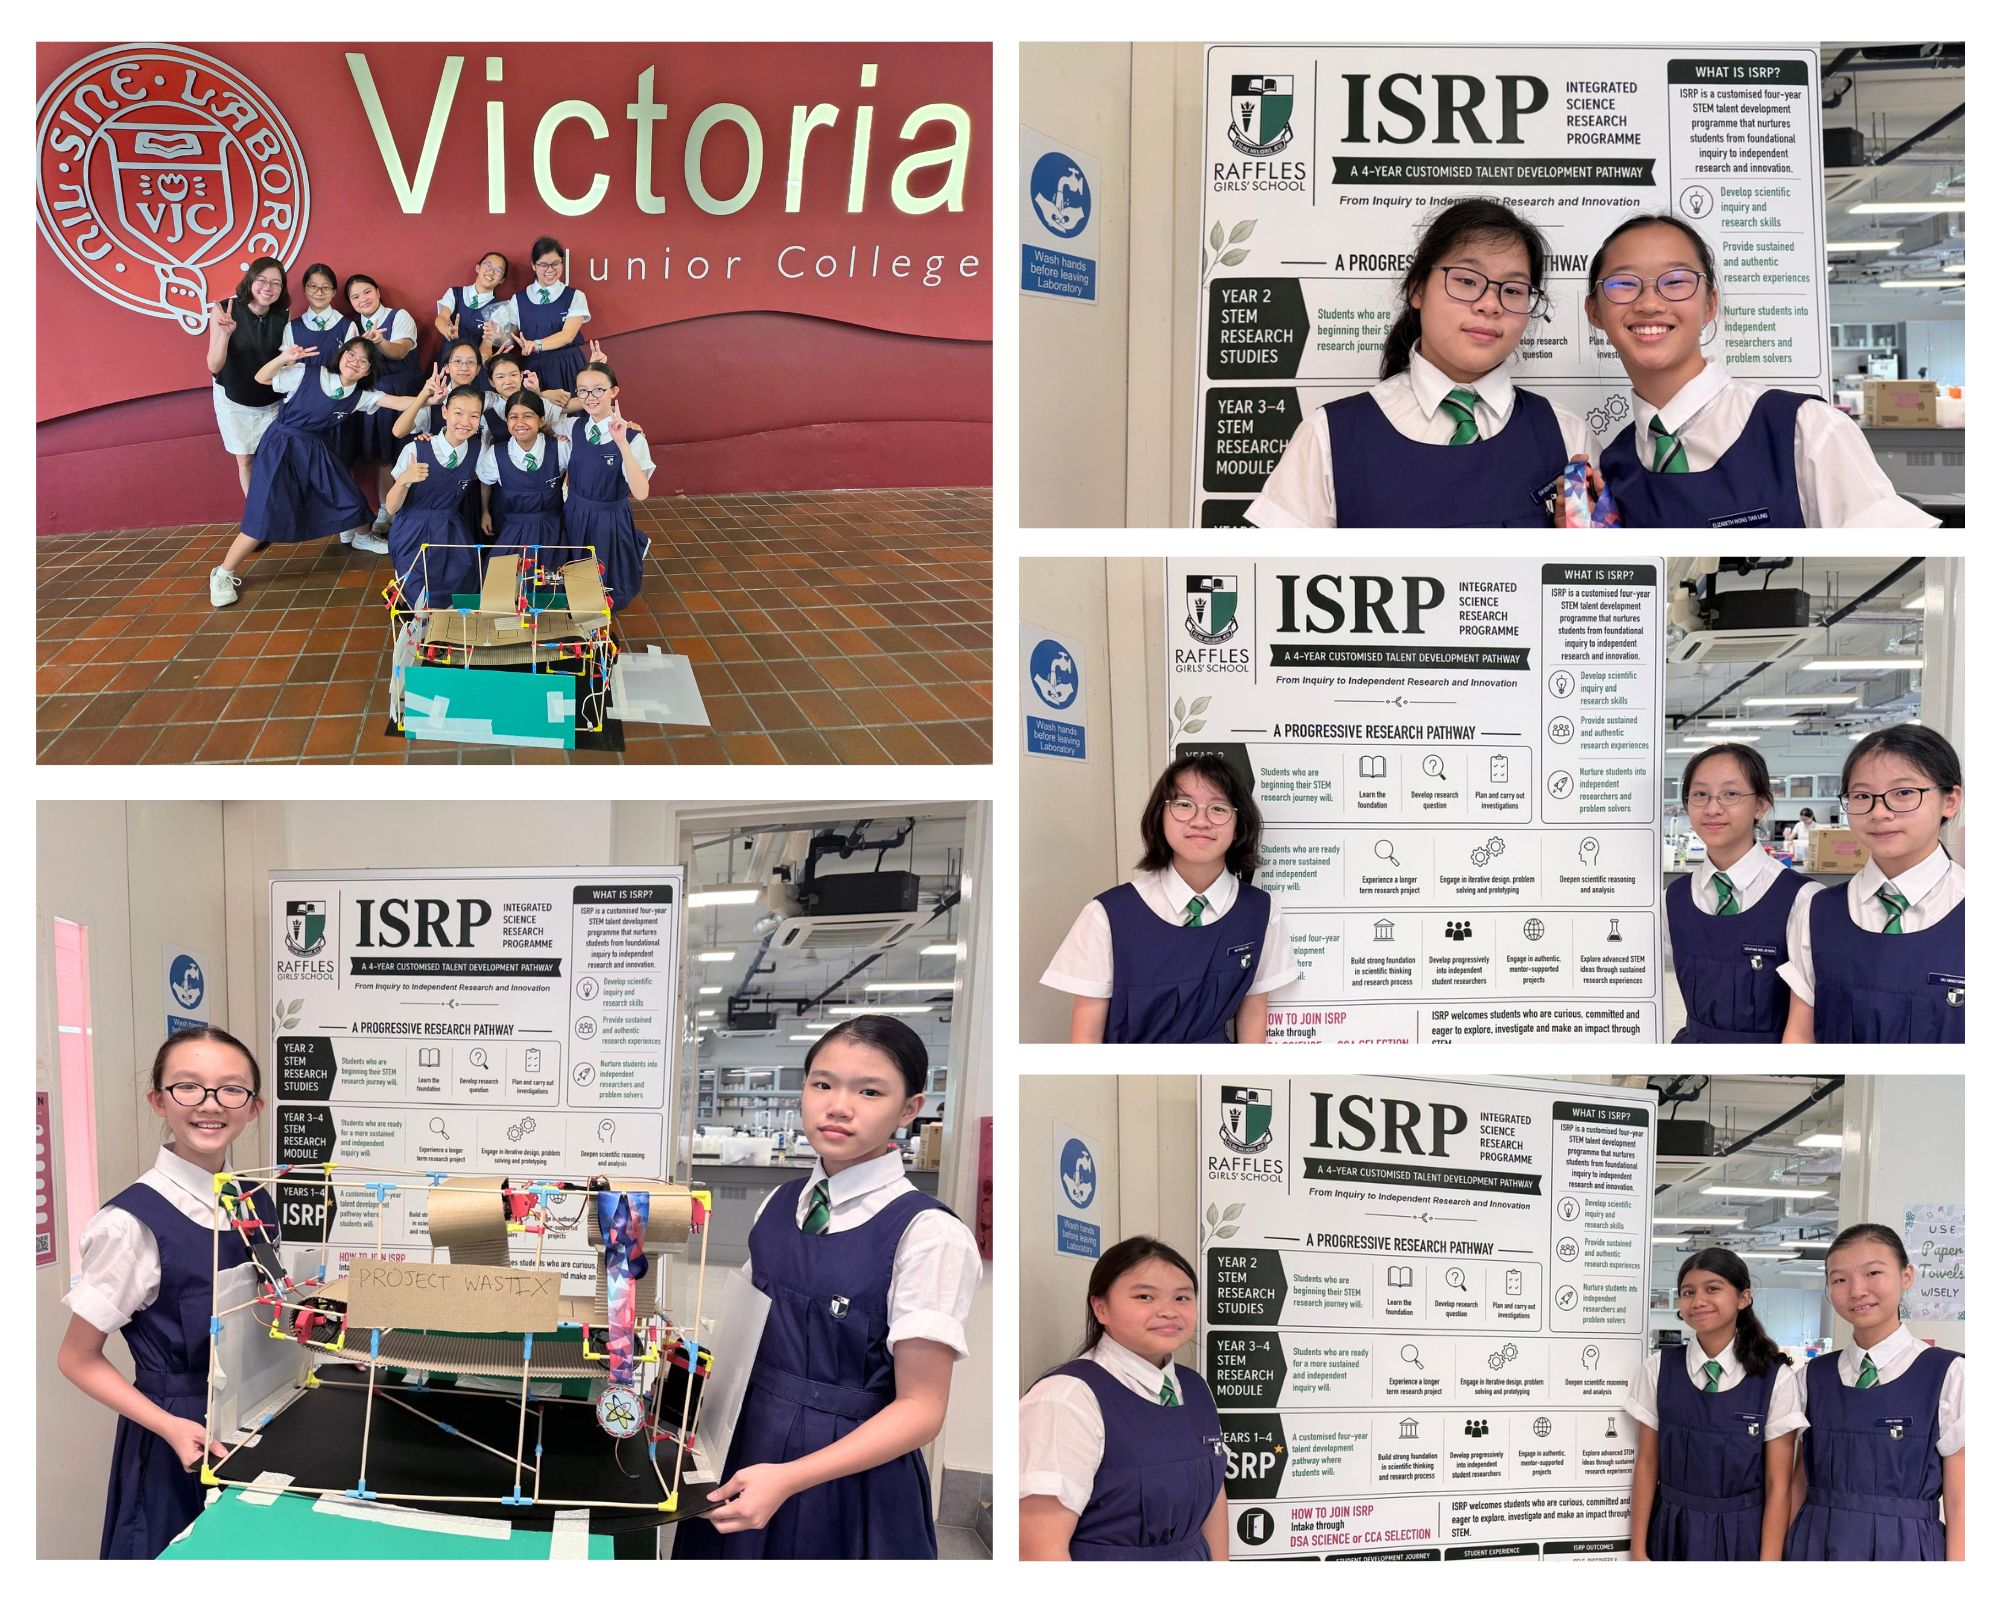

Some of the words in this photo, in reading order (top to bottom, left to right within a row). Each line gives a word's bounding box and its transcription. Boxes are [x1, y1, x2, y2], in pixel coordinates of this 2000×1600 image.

[1696, 67, 1729, 77] WHAT
[1734, 67, 1744, 77] IS
[1749, 67, 1780, 78] ISRP?
[1567, 82, 1637, 93] INTEGRATED
[1680, 88, 1698, 98] ISRP
[1701, 89, 1708, 98] is
[1717, 89, 1762, 98] customised
[1341, 73, 1548, 144] ISRP
[1567, 98, 1615, 110] SCIENCE
[1693, 103, 1714, 112] STEM
[1716, 104, 1738, 113] talent
[1741, 104, 1790, 115] development
[1567, 115, 1626, 126] RESEARCH
[1692, 120, 1738, 130] programme
[1740, 118, 1755, 127] that
[1758, 119, 1790, 128] nurtures
[345, 53, 970, 216] Victoria
[1568, 133, 1640, 144] PROGRAMME
[1690, 133, 1724, 142] students
[1726, 133, 1745, 142] from
[1747, 134, 1796, 143] foundational
[1700, 148, 1727, 160] inquiry
[1730, 149, 1737, 157] to
[1740, 148, 1788, 160] independent
[1214, 162, 1306, 180] RAFFLES
[1351, 166, 1358, 176] A
[1406, 166, 1472, 177] CUSTOMISED
[1476, 166, 1514, 177] TALENT
[1518, 167, 1592, 177] DEVELOPMENT
[1596, 167, 1642, 178] PATHWAY
[1696, 163, 1730, 172] research
[1733, 163, 1748, 172] and
[1750, 163, 1793, 172] innovation.
[1253, 180, 1306, 192] SCHOOL
[1340, 196, 1368, 206] From
[1372, 196, 1412, 208] Inquiry
[1414, 197, 1426, 206] to
[1503, 197, 1555, 206] Research
[1559, 197, 1578, 206] and
[1582, 197, 1640, 206] Innovation
[136, 203, 218, 243] VJC
[777, 246, 981, 286] College
[1034, 250, 1059, 265] Wash
[1062, 256, 1086, 271] hands
[1031, 262, 1058, 278] before
[1061, 268, 1088, 285] leaving
[1038, 277, 1082, 296] Laboratory
[1222, 290, 1257, 303] YEAR
[1263, 289, 1270, 302] 2
[1222, 309, 1257, 323] STEM
[1222, 329, 1292, 343] RESEARCH
[1220, 349, 1278, 363] STUDIES
[1218, 400, 1252, 414] YEAR
[1218, 420, 1253, 434] STEM
[1217, 440, 1290, 454] RESEARCH
[1216, 460, 1274, 474] MODULE
[1276, 574, 1444, 634] ISRP
[1176, 649, 1249, 664] RAFFLES
[1207, 664, 1249, 672] SCHOOL
[1303, 676, 1334, 686] Inquiry
[1348, 677, 1405, 686] Independent
[1471, 679, 1517, 687] Innovation
[1581, 671, 1606, 681] Develop
[1608, 671, 1637, 679] scientific
[1581, 684, 1603, 694] inquiry
[1605, 684, 1617, 692] and
[1581, 716, 1605, 724] Provide
[1607, 716, 1637, 724] sustained
[1274, 724, 1281, 737] A
[1285, 724, 1362, 738] PROGRESSIVE
[1366, 725, 1422, 739] RESEARCH
[1427, 726, 1475, 739] PATHWAY
[1611, 741, 1649, 750] experiences
[630, 890, 653, 898] ISRP?
[356, 898, 491, 948] ISRP
[1581, 955, 1601, 963] Explore
[1432, 1011, 1449, 1020] ISRP
[1451, 1011, 1488, 1020] welcomes
[1490, 1010, 1520, 1019] students
[1523, 1009, 1538, 1018] who
[1586, 1010, 1624, 1018] committed
[1626, 1010, 1639, 1018] and
[284, 1044, 305, 1052] YEAR
[309, 1044, 313, 1052] 2
[284, 1056, 306, 1065] STEM
[284, 1069, 327, 1078] RESEARCH
[284, 1082, 318, 1091] STUDIES
[1310, 1092, 1467, 1157] ISRP
[1208, 1157, 1283, 1174] RAFFLES
[1240, 1173, 1283, 1182] SCHOOL
[1929, 1225, 1956, 1234] USE
[1922, 1240, 1964, 1263] Paper
[1919, 1263, 1965, 1279] Towels
[361, 1268, 448, 1291] PROJECT
[1921, 1288, 1960, 1297] WISELY
[1299, 1432, 1336, 1440] customised
[1313, 1444, 1353, 1453] development
[1292, 1457, 1320, 1466] pathway
[1292, 1508, 1313, 1520] HOW
[1316, 1507, 1326, 1518] TO
[1330, 1506, 1350, 1518] JOIN
[1353, 1505, 1373, 1516] ISRP
[1292, 1522, 1314, 1531] Intake
[1316, 1520, 1344, 1531] through
[1290, 1536, 1308, 1547] DSA
[1312, 1533, 1350, 1546] SCIENCE
[1353, 1535, 1362, 1543] or
[1365, 1532, 1382, 1542] CCA
[1385, 1529, 1430, 1541] SELECTION
[1464, 1549, 1488, 1558] STUDENT
[1488, 1547, 1520, 1556] EXPERIENCE
